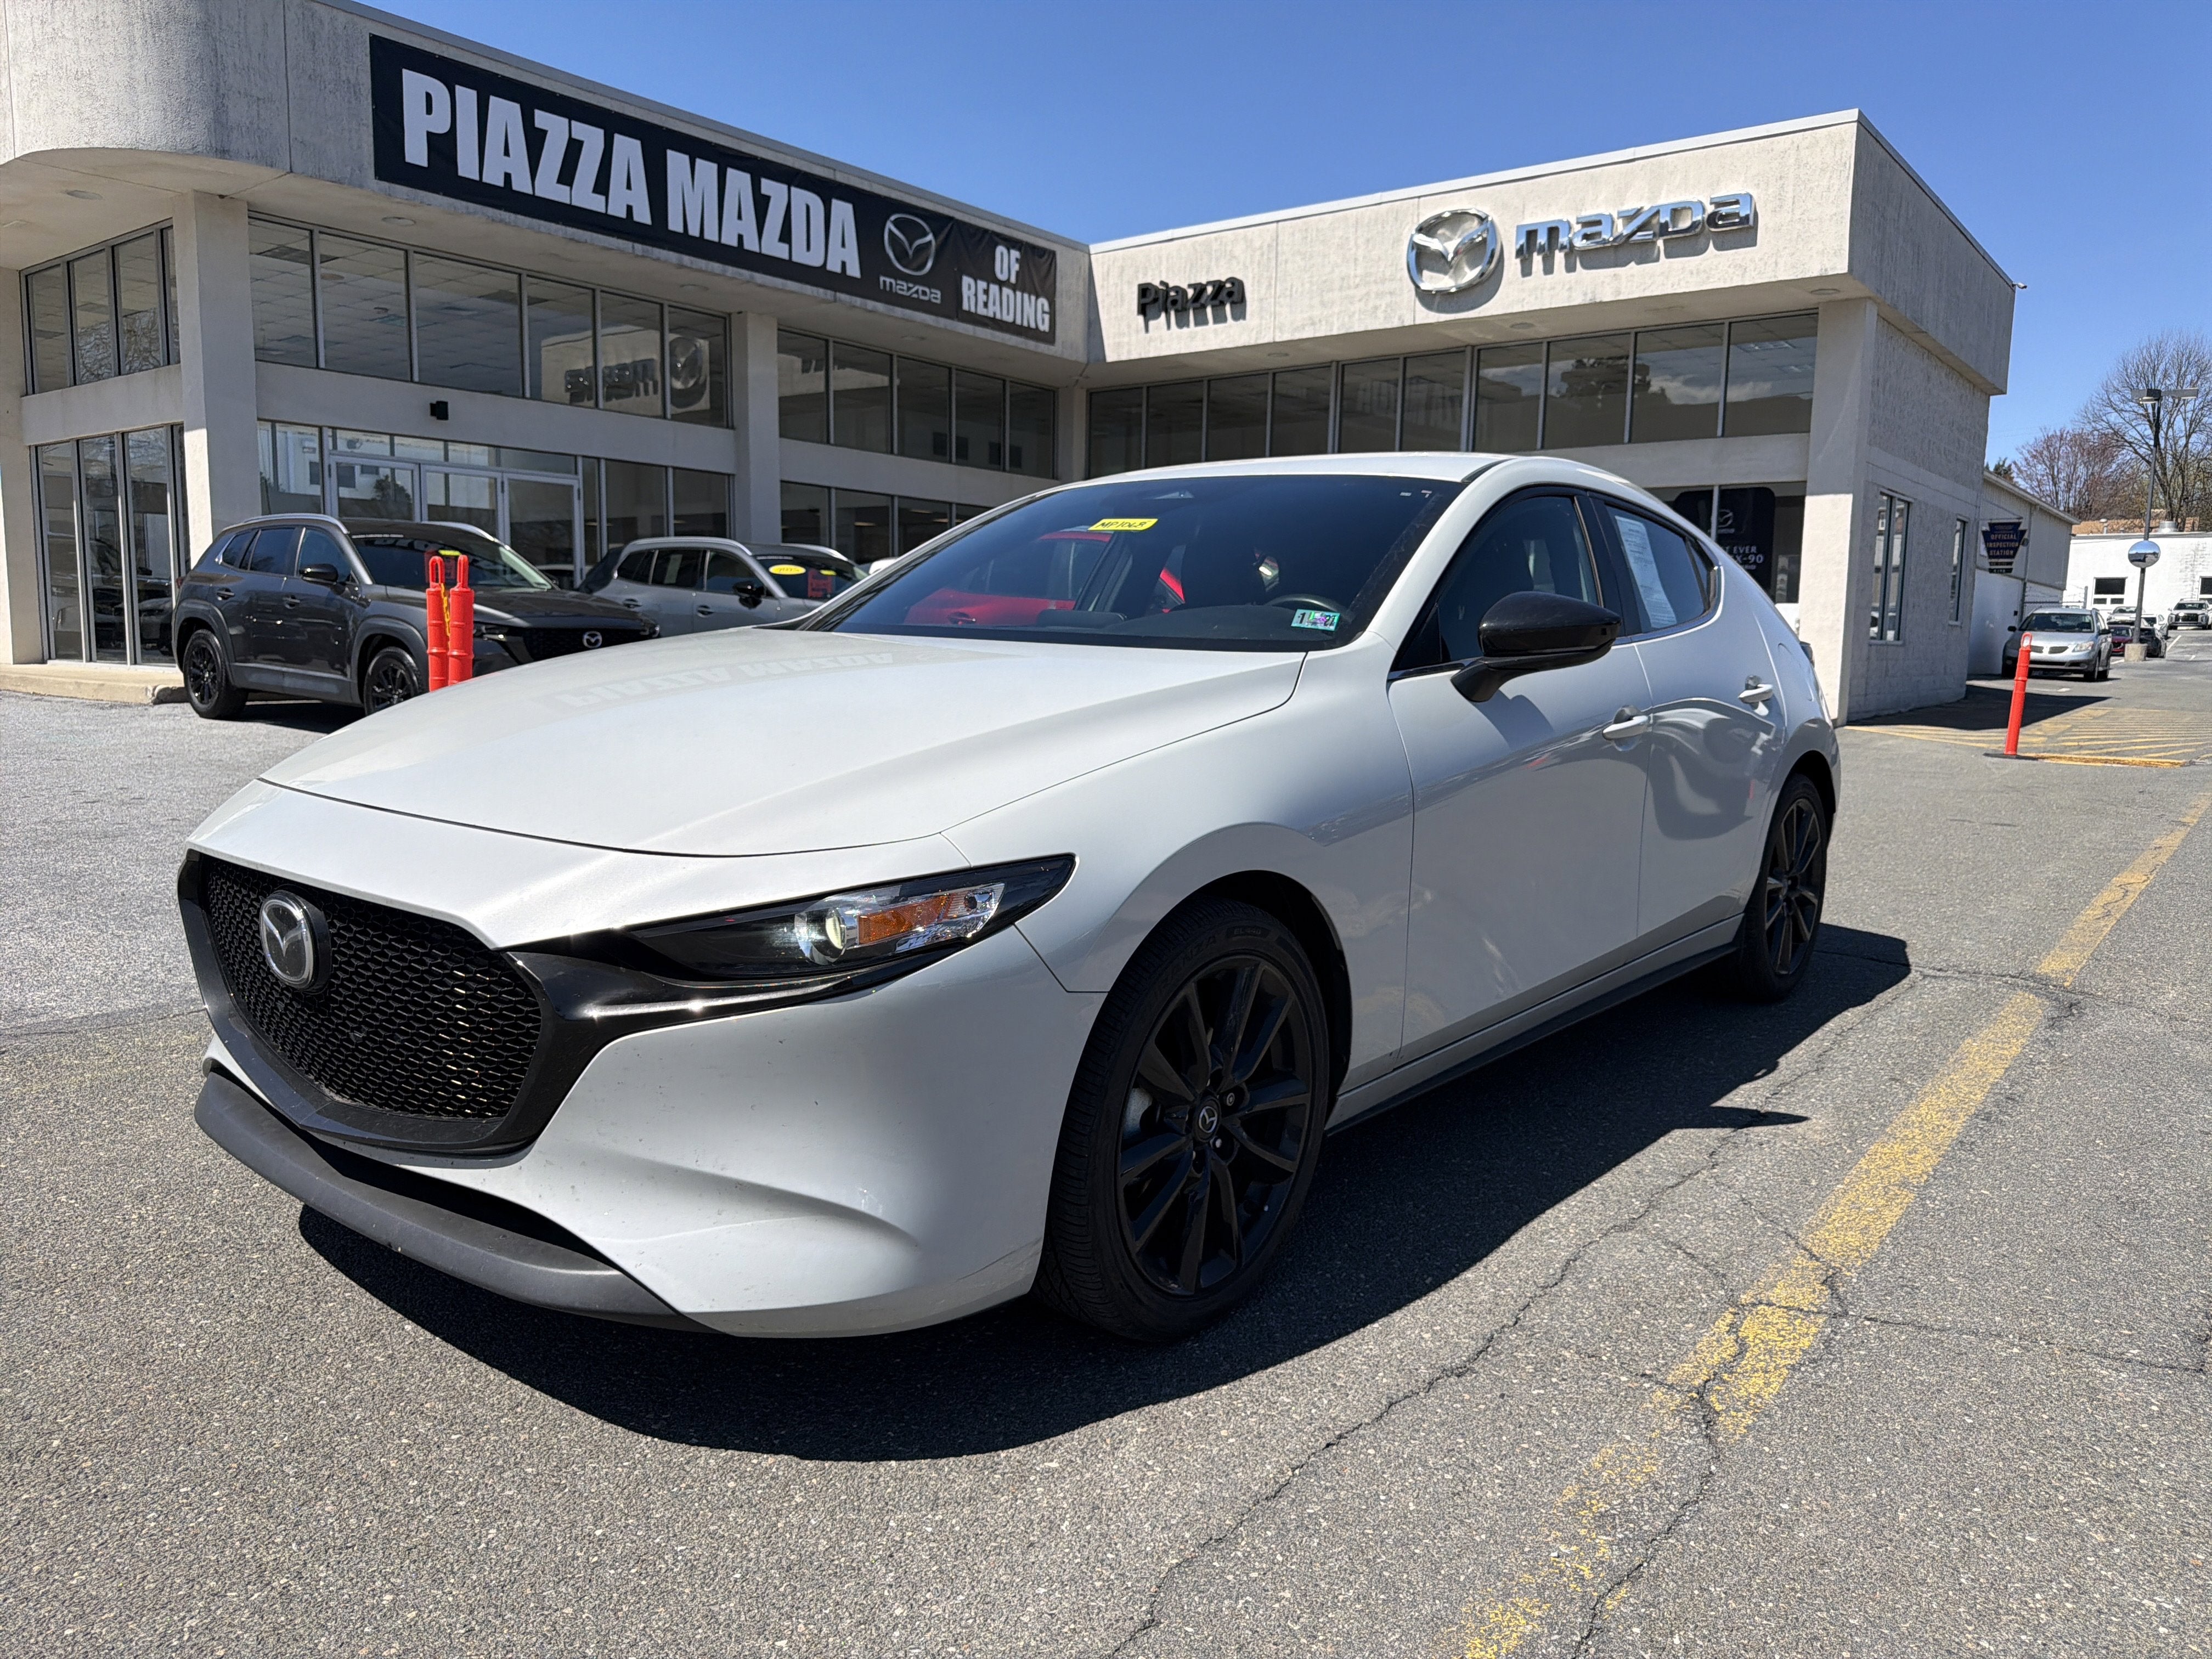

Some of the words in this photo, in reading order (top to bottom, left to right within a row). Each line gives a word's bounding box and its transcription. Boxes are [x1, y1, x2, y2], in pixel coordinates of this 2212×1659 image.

[402, 69, 652, 225] PIAZZA
[667, 149, 861, 278] MAZDA
[1516, 190, 1757, 259] mazda
[995, 245, 1020, 284] OF
[879, 274, 941, 304] mazda
[962, 275, 1050, 332] READING
[1137, 277, 1246, 316] Piazza
[1733, 545, 1757, 554] EVER
